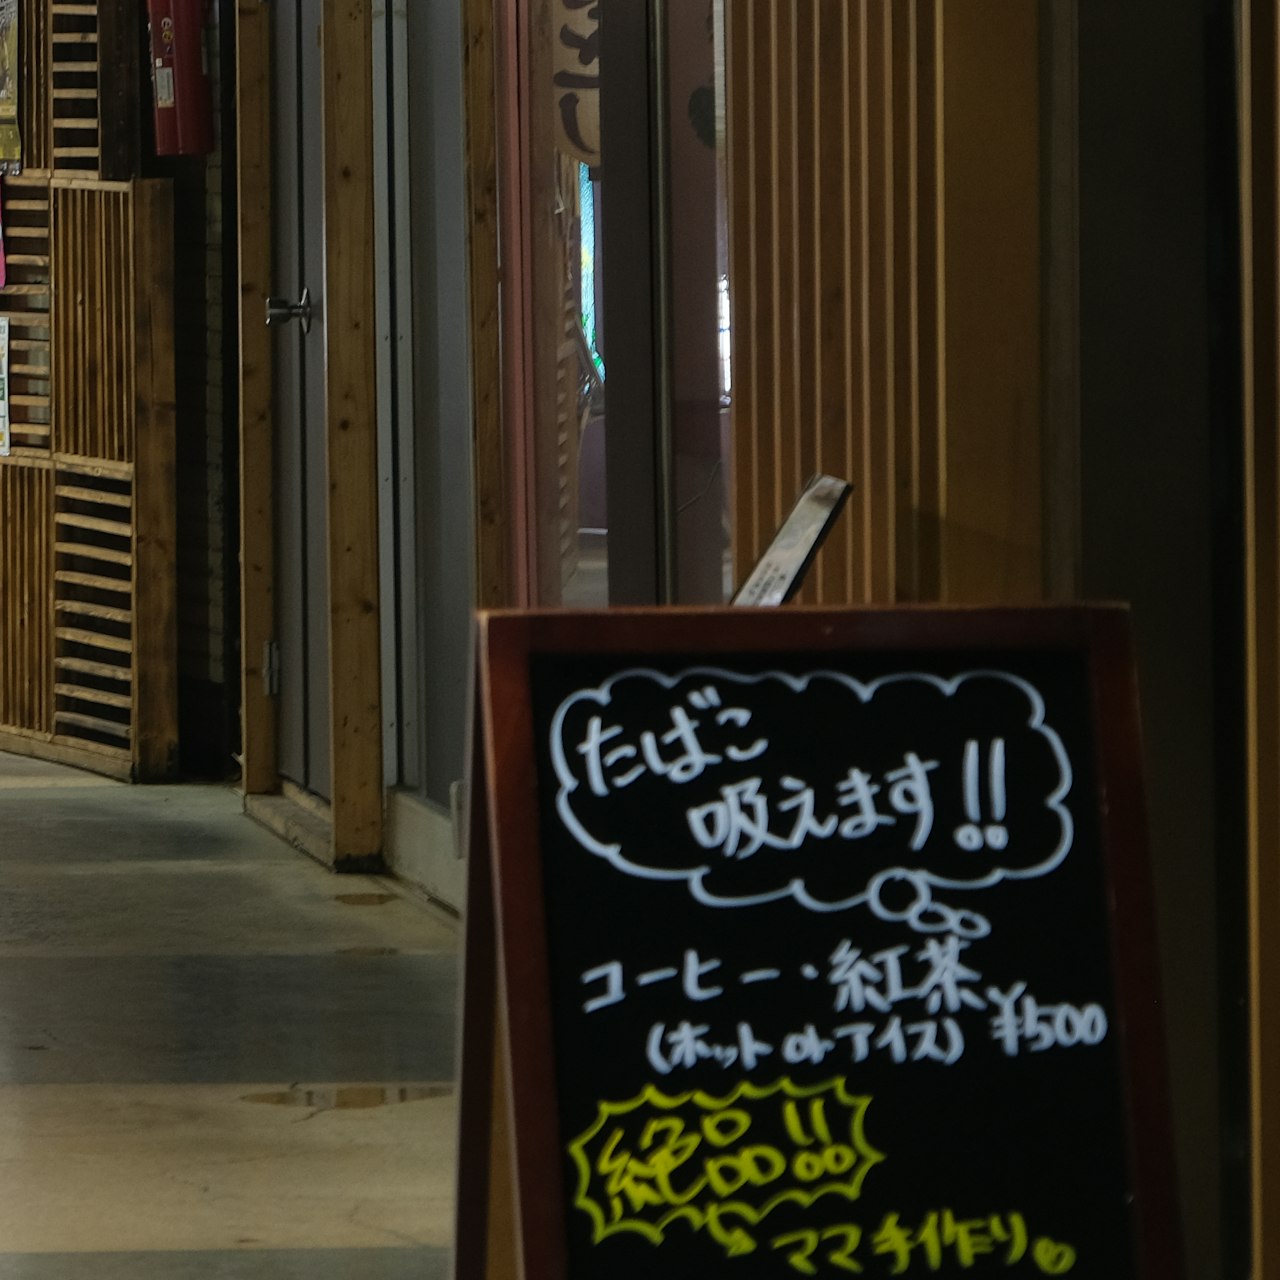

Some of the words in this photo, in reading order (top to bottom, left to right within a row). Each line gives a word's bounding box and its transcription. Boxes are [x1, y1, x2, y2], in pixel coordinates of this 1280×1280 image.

[578, 687, 768, 796] たばこ
[581, 937, 986, 1013] コーヒー・紅茶
[988, 984, 1109, 1058] ¥500
